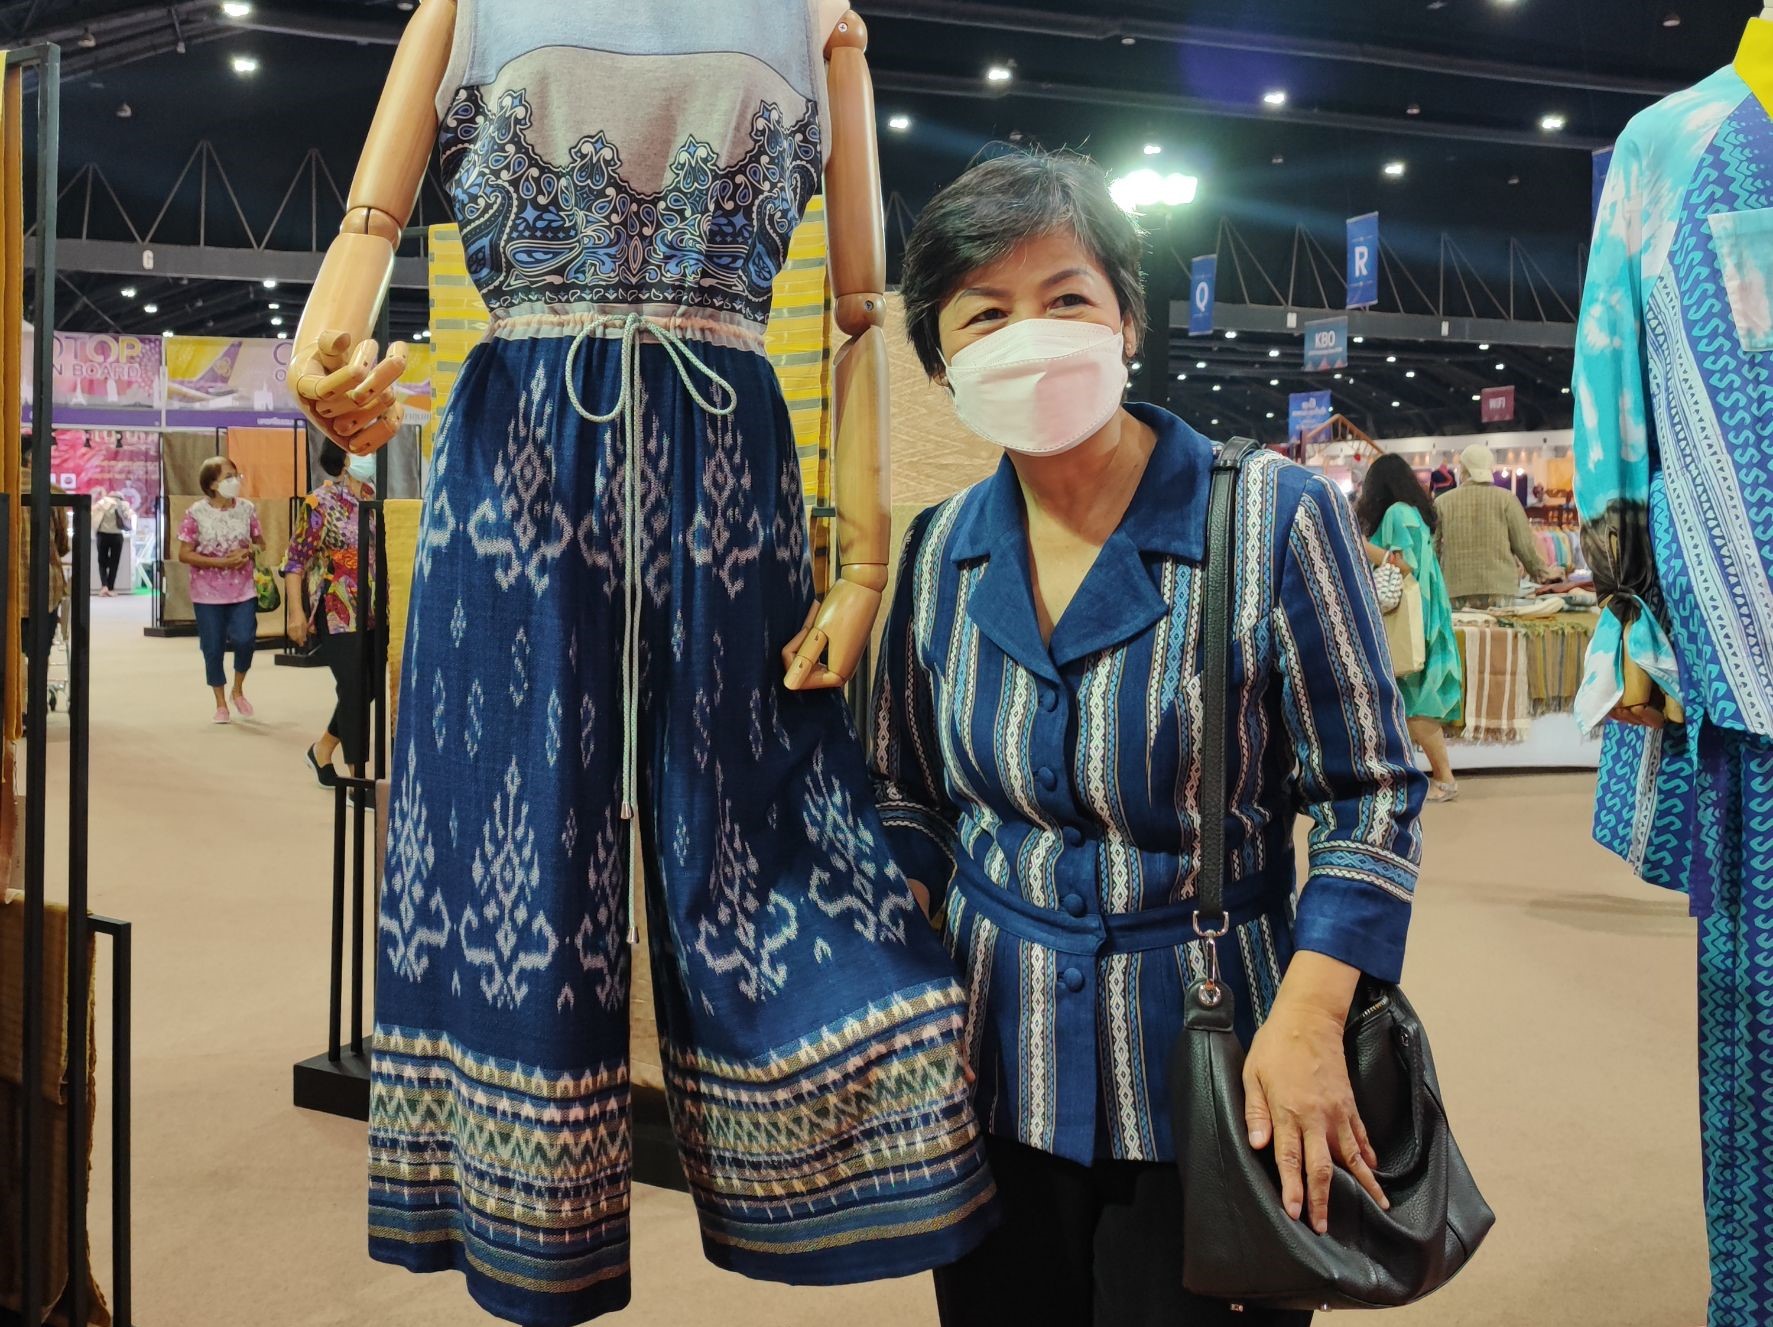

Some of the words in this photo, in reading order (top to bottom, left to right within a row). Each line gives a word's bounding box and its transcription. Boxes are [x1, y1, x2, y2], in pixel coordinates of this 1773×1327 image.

[1354, 246, 1368, 277] R
[1195, 281, 1209, 312] Q
[1315, 330, 1336, 349] KBO
[52, 363, 63, 376] N
[72, 363, 142, 378] BOARD
